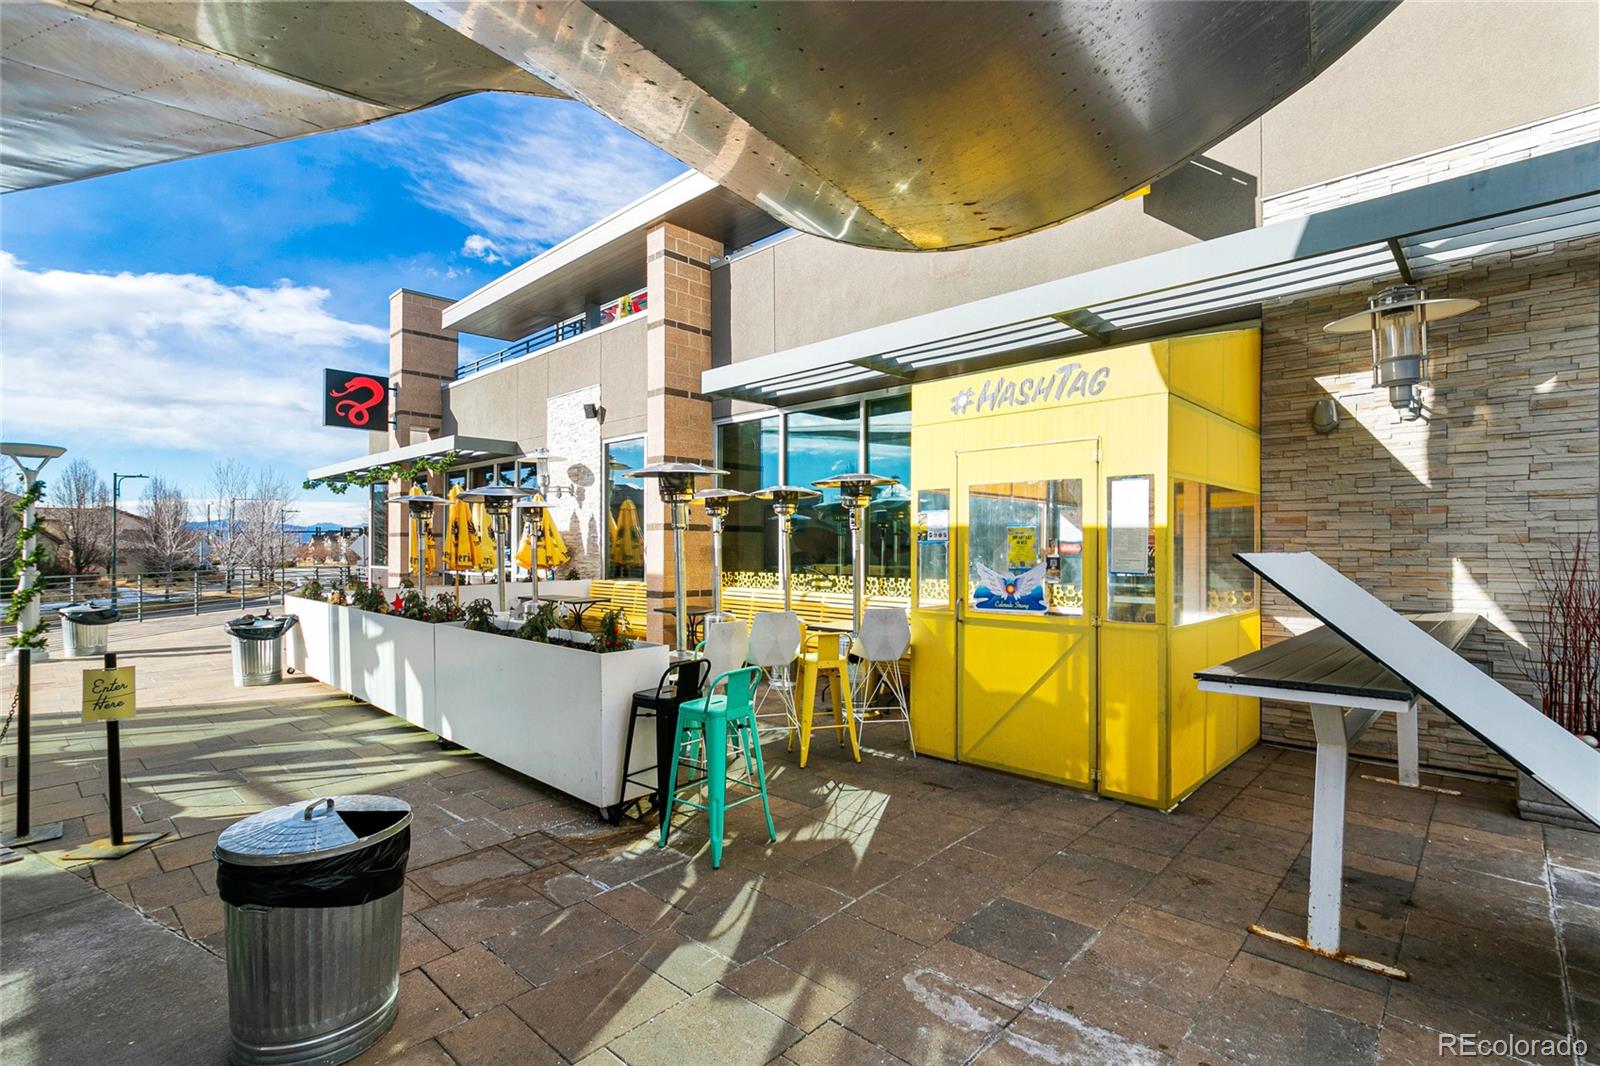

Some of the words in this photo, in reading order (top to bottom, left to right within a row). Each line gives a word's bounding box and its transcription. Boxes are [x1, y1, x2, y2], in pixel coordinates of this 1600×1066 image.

[950, 362, 1111, 415] #HASHTAG
[91, 678, 128, 694] Enter
[92, 693, 125, 711] Here
